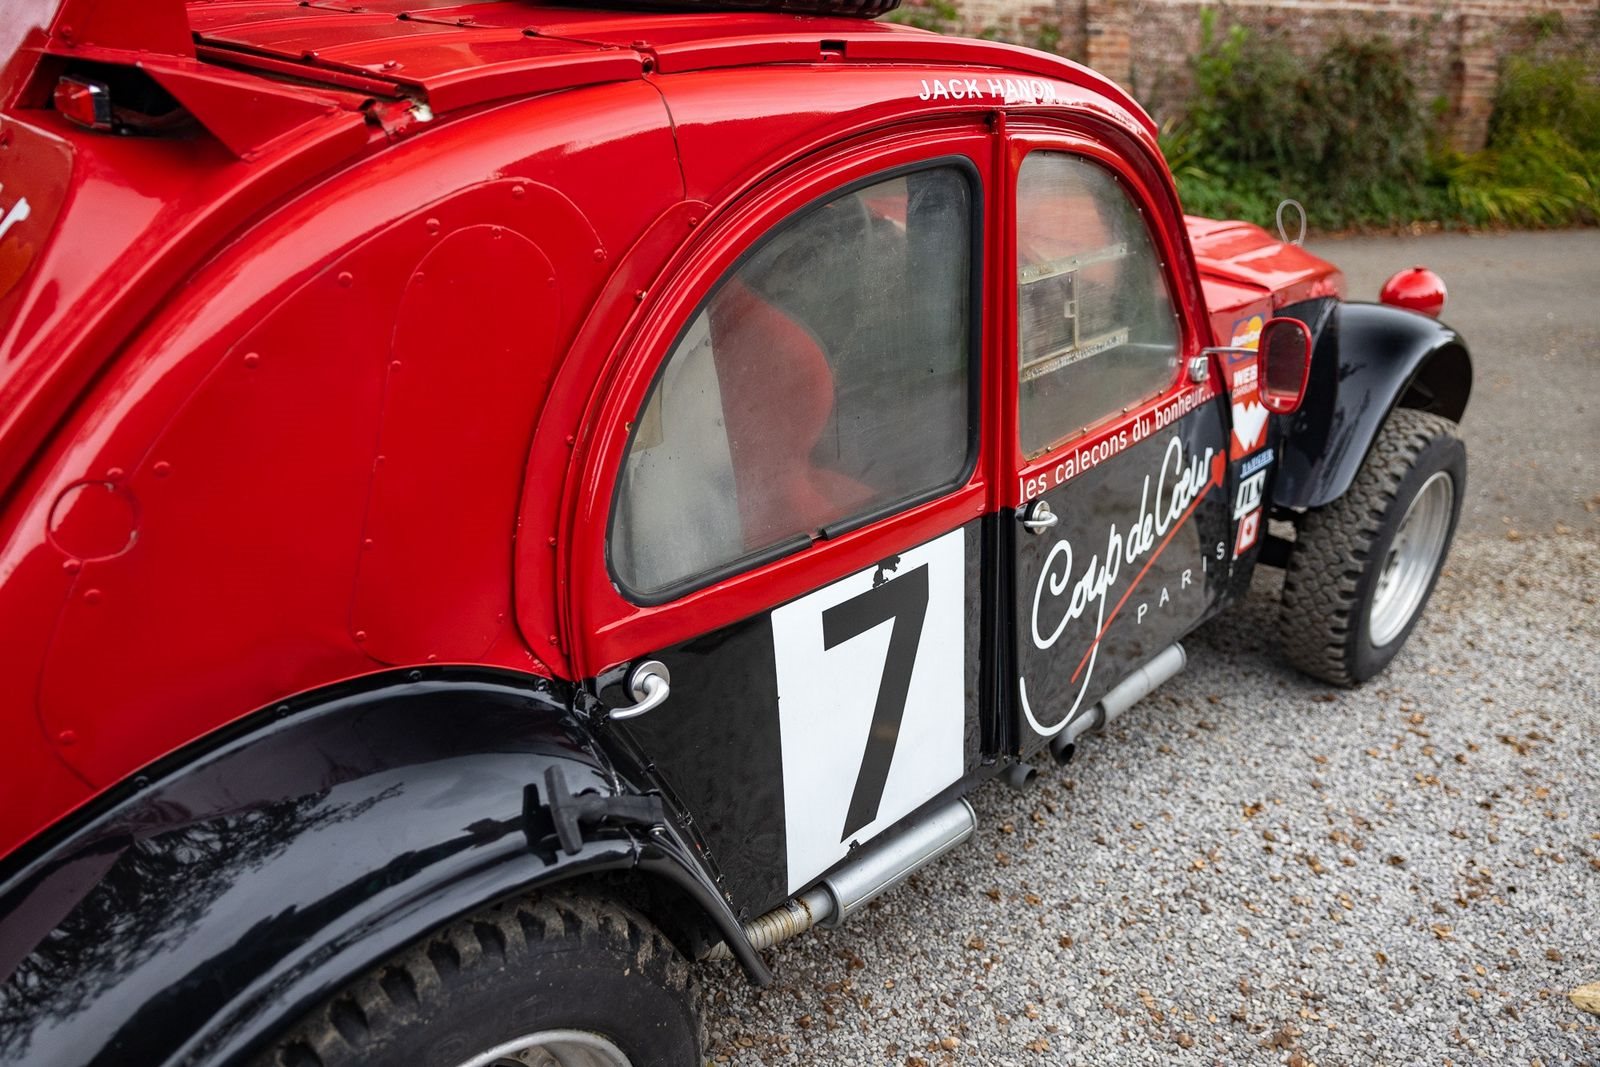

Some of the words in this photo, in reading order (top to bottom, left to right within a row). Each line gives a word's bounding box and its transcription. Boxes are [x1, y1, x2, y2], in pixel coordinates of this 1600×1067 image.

[918, 78, 983, 101] JACK
[1019, 472, 1047, 504] les
[1055, 429, 1128, 485] caleçons
[1132, 415, 1150, 443] du
[1020, 522, 1123, 737] Coup
[1125, 474, 1155, 563] de
[1137, 542, 1225, 624] PARIS
[821, 562, 929, 844] 7
